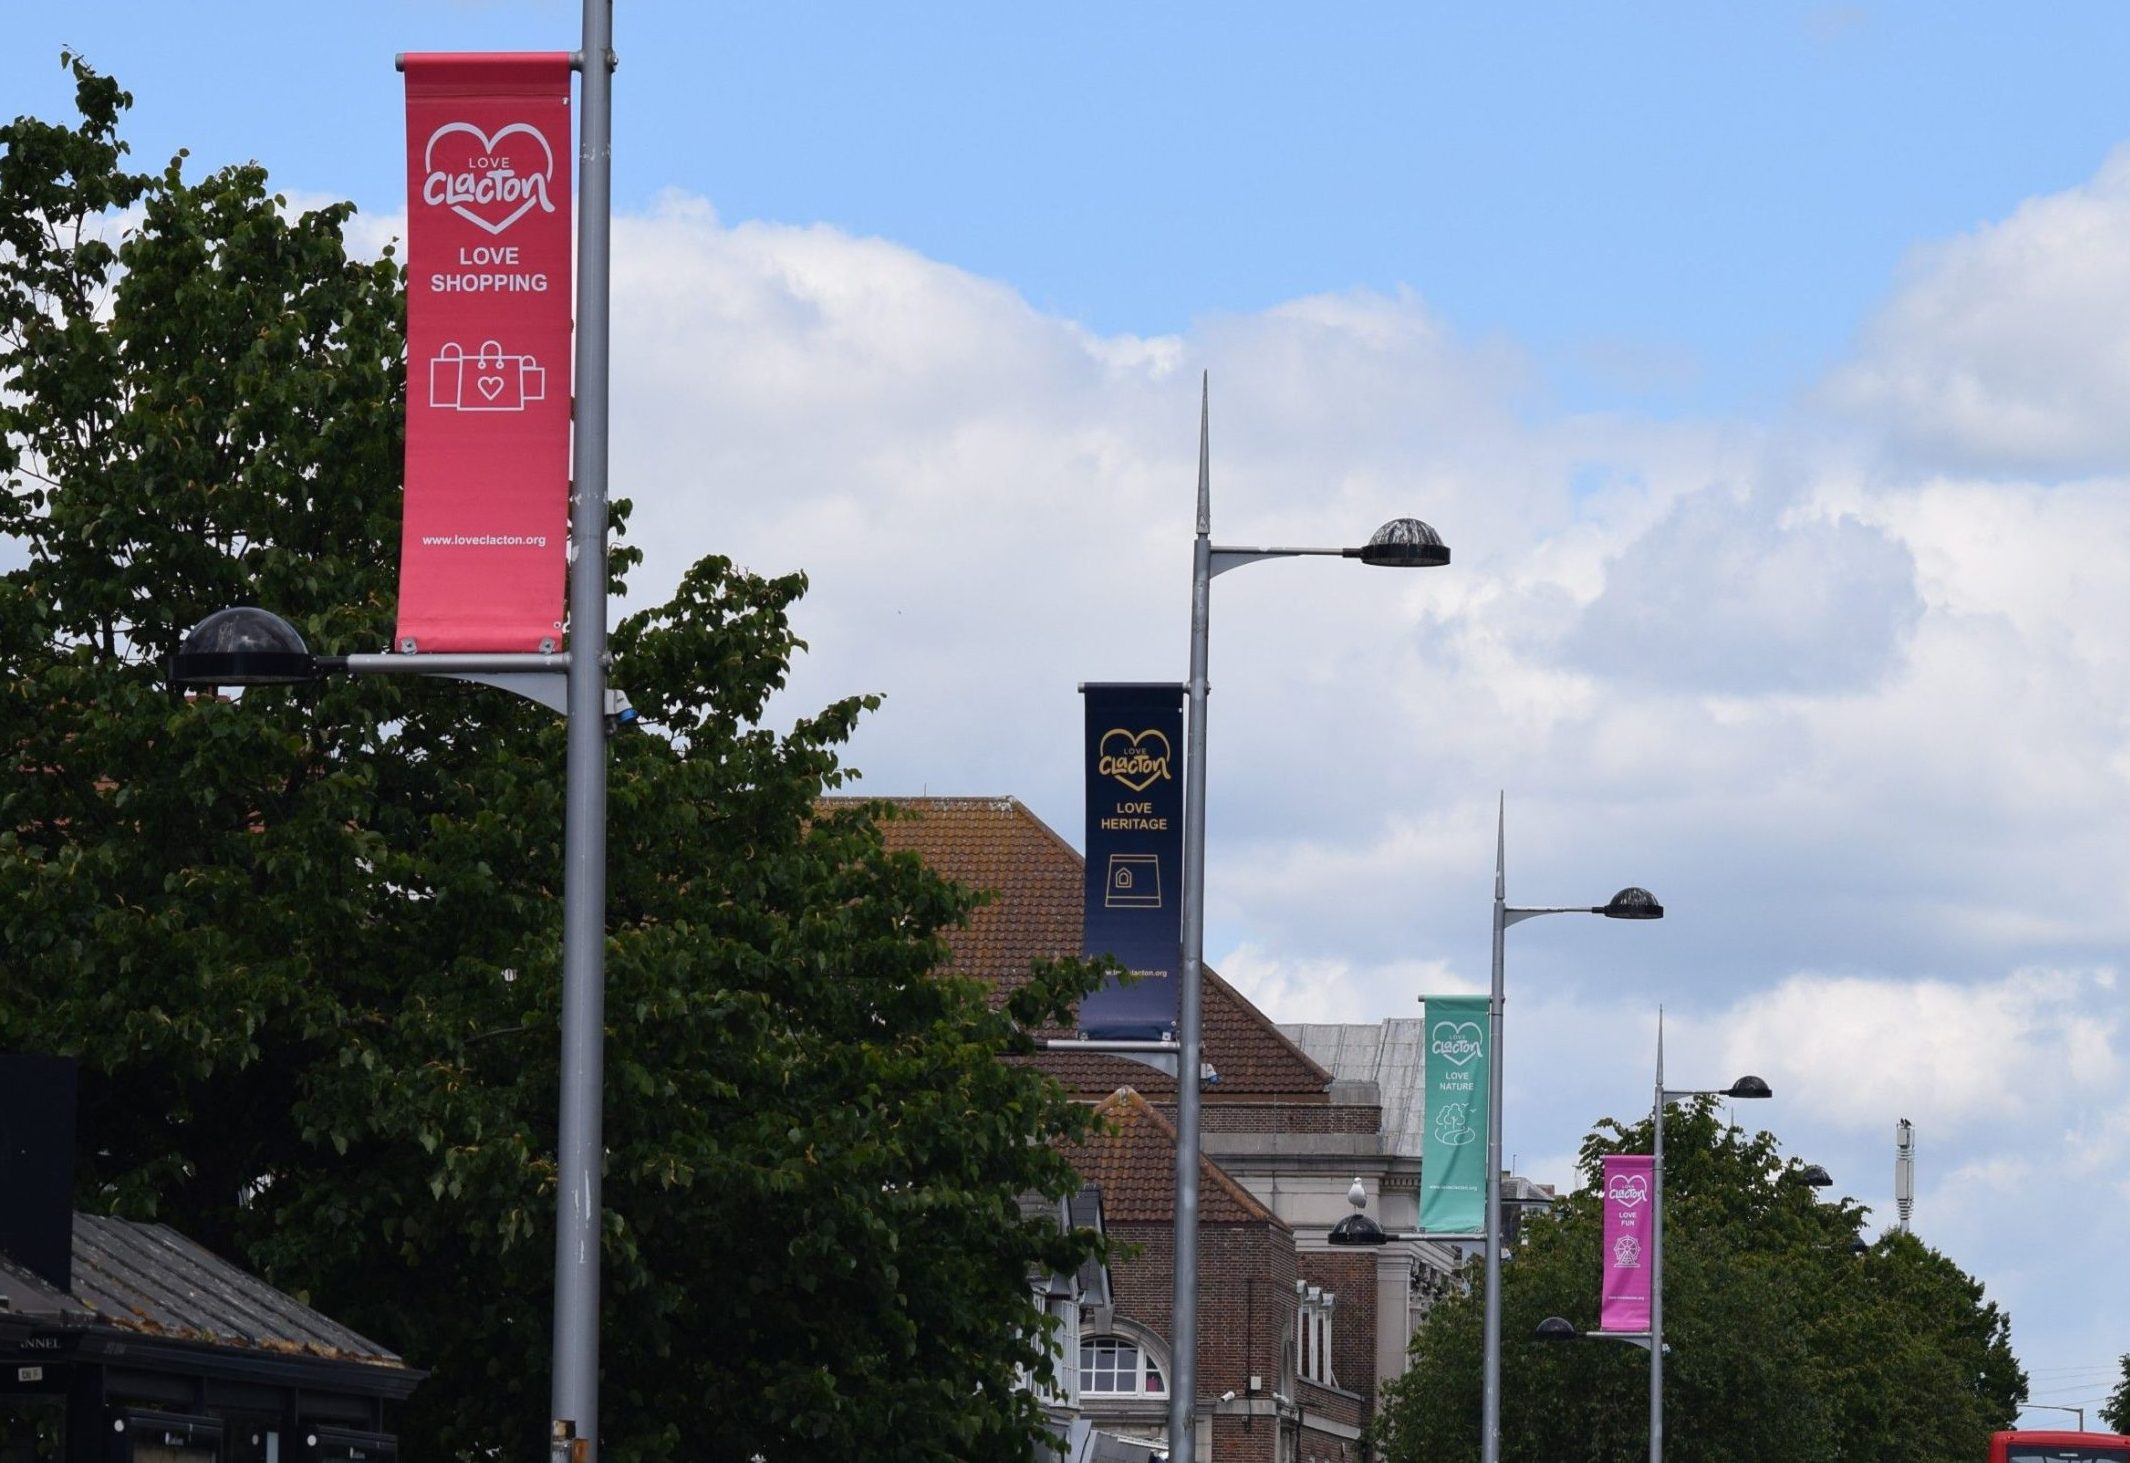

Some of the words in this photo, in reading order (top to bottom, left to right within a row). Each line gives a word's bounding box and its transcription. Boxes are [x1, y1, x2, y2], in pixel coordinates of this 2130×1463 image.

[468, 157, 511, 169] LOVE
[459, 247, 520, 265] LOVE
[430, 274, 548, 292] SHOPPING
[422, 534, 547, 547] www.loveclacton.org
[1123, 747, 1147, 755] LOVE
[1116, 802, 1152, 814] LOVE
[1100, 817, 1168, 830] HERITAGE
[1445, 1071, 1469, 1080] LOVE
[1439, 1082, 1474, 1091] NATURE
[19, 1336, 62, 1350] NNEL
